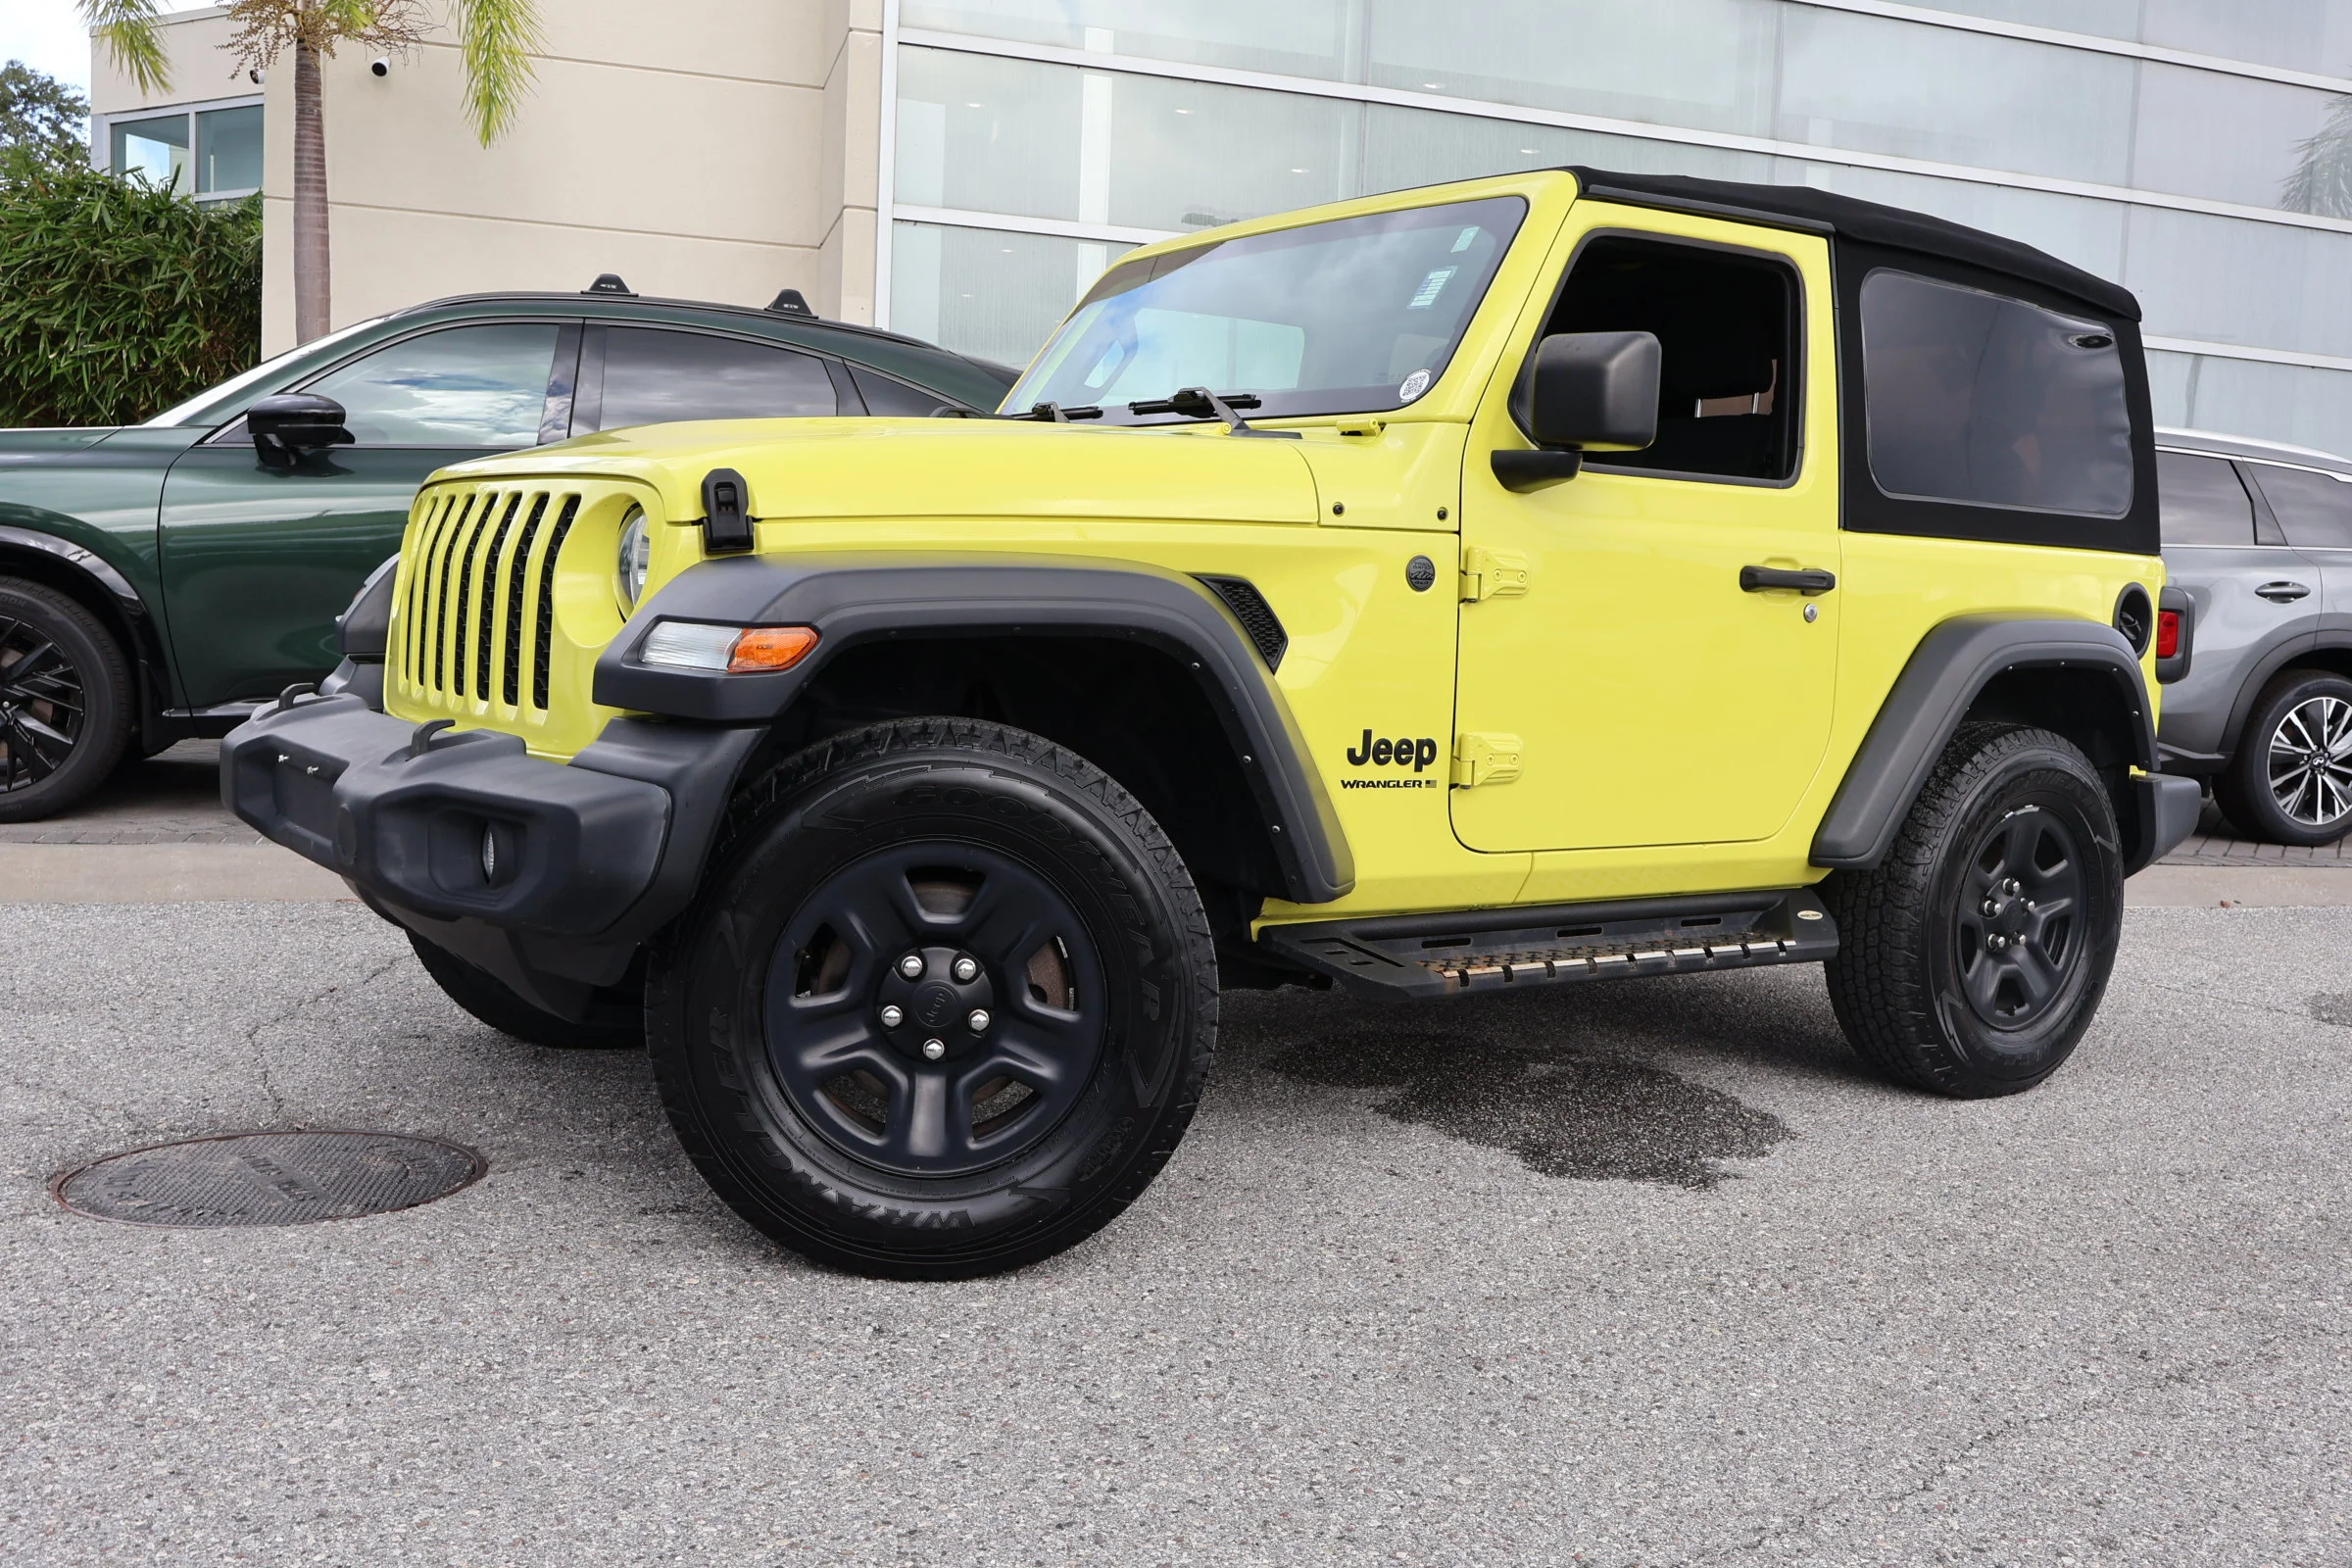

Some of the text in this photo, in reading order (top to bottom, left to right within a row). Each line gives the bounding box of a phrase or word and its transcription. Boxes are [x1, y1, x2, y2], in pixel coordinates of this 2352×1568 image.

[1347, 728, 1438, 772] Jeep
[1341, 779, 1423, 789] WRANGLER
[897, 784, 1161, 1021] GOODYEAR
